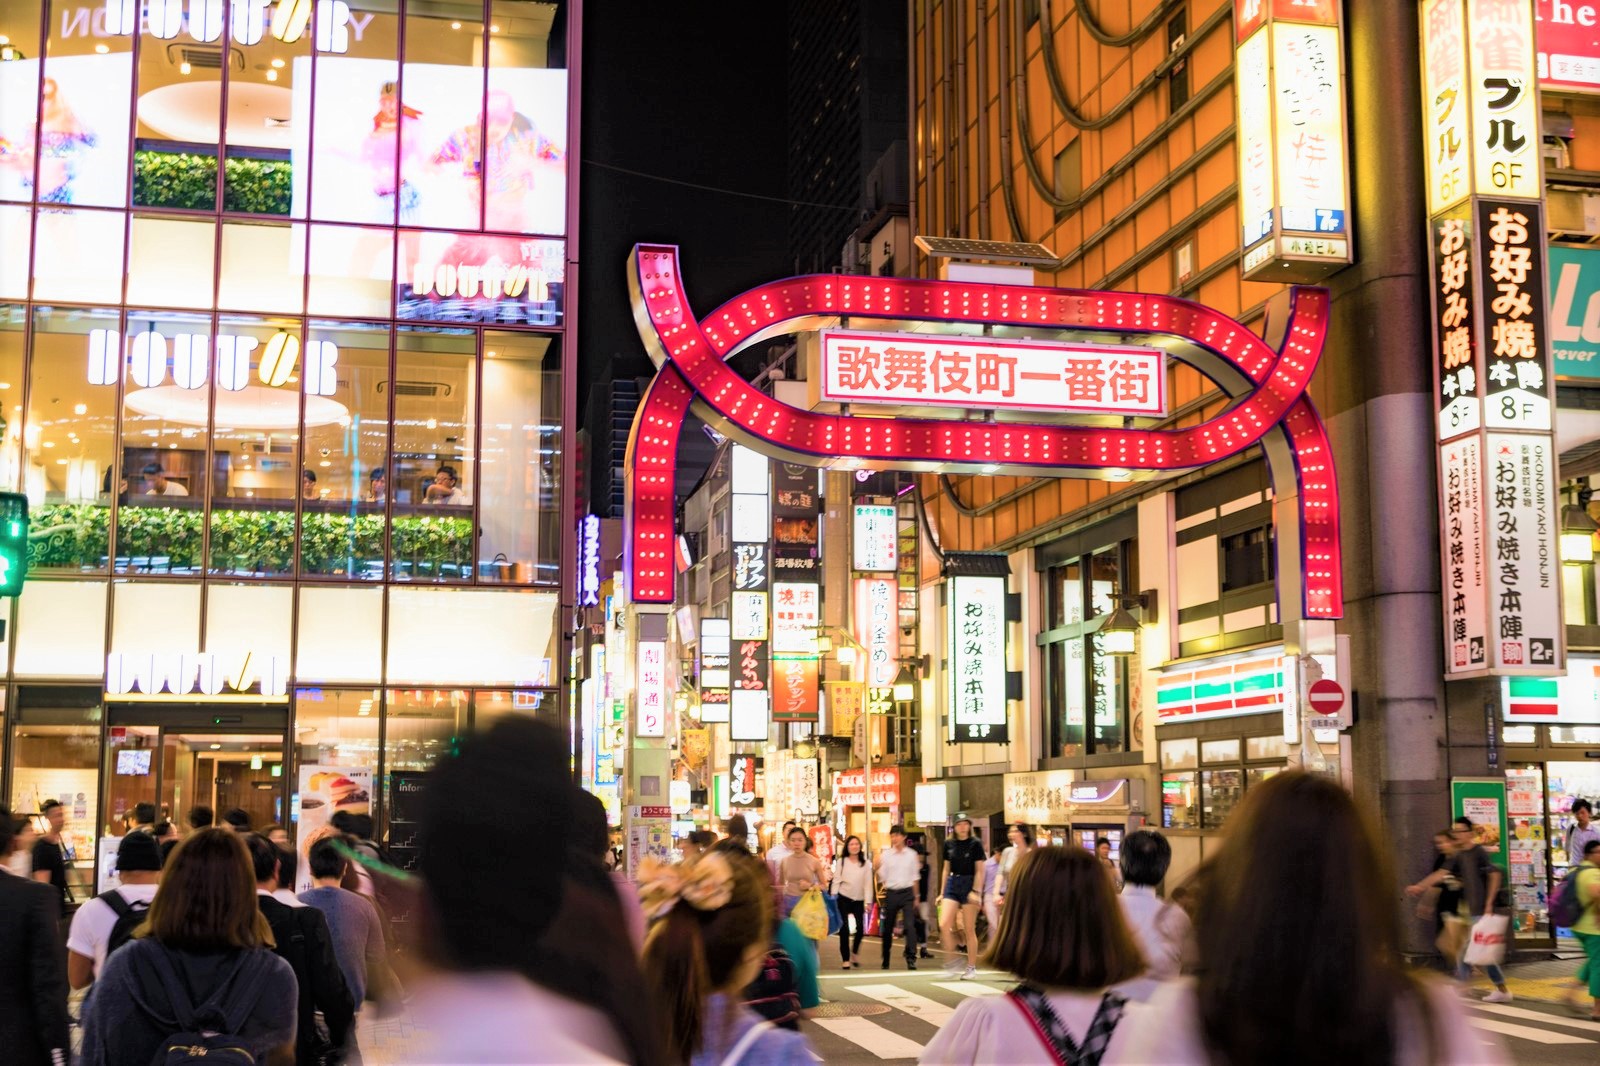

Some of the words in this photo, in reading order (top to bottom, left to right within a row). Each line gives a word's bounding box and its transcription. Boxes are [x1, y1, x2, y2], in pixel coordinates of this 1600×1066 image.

[1491, 162, 1523, 189] 6F
[1439, 219, 1471, 369] お好み焼
[1489, 208, 1537, 358] お好み焼
[88, 328, 338, 396] DOUTOR
[837, 346, 1150, 404] 歌舞伎町一番街
[1501, 396, 1534, 420] 8F
[1534, 445, 1546, 535] OKONOMIYAKI
[1448, 467, 1467, 642] お好み焼き本陣
[1495, 461, 1525, 640] お好み焼き本陣
[1539, 540, 1550, 588] HONJIN
[1531, 641, 1554, 660] 2F
[645, 649, 660, 728] 劇場通り
